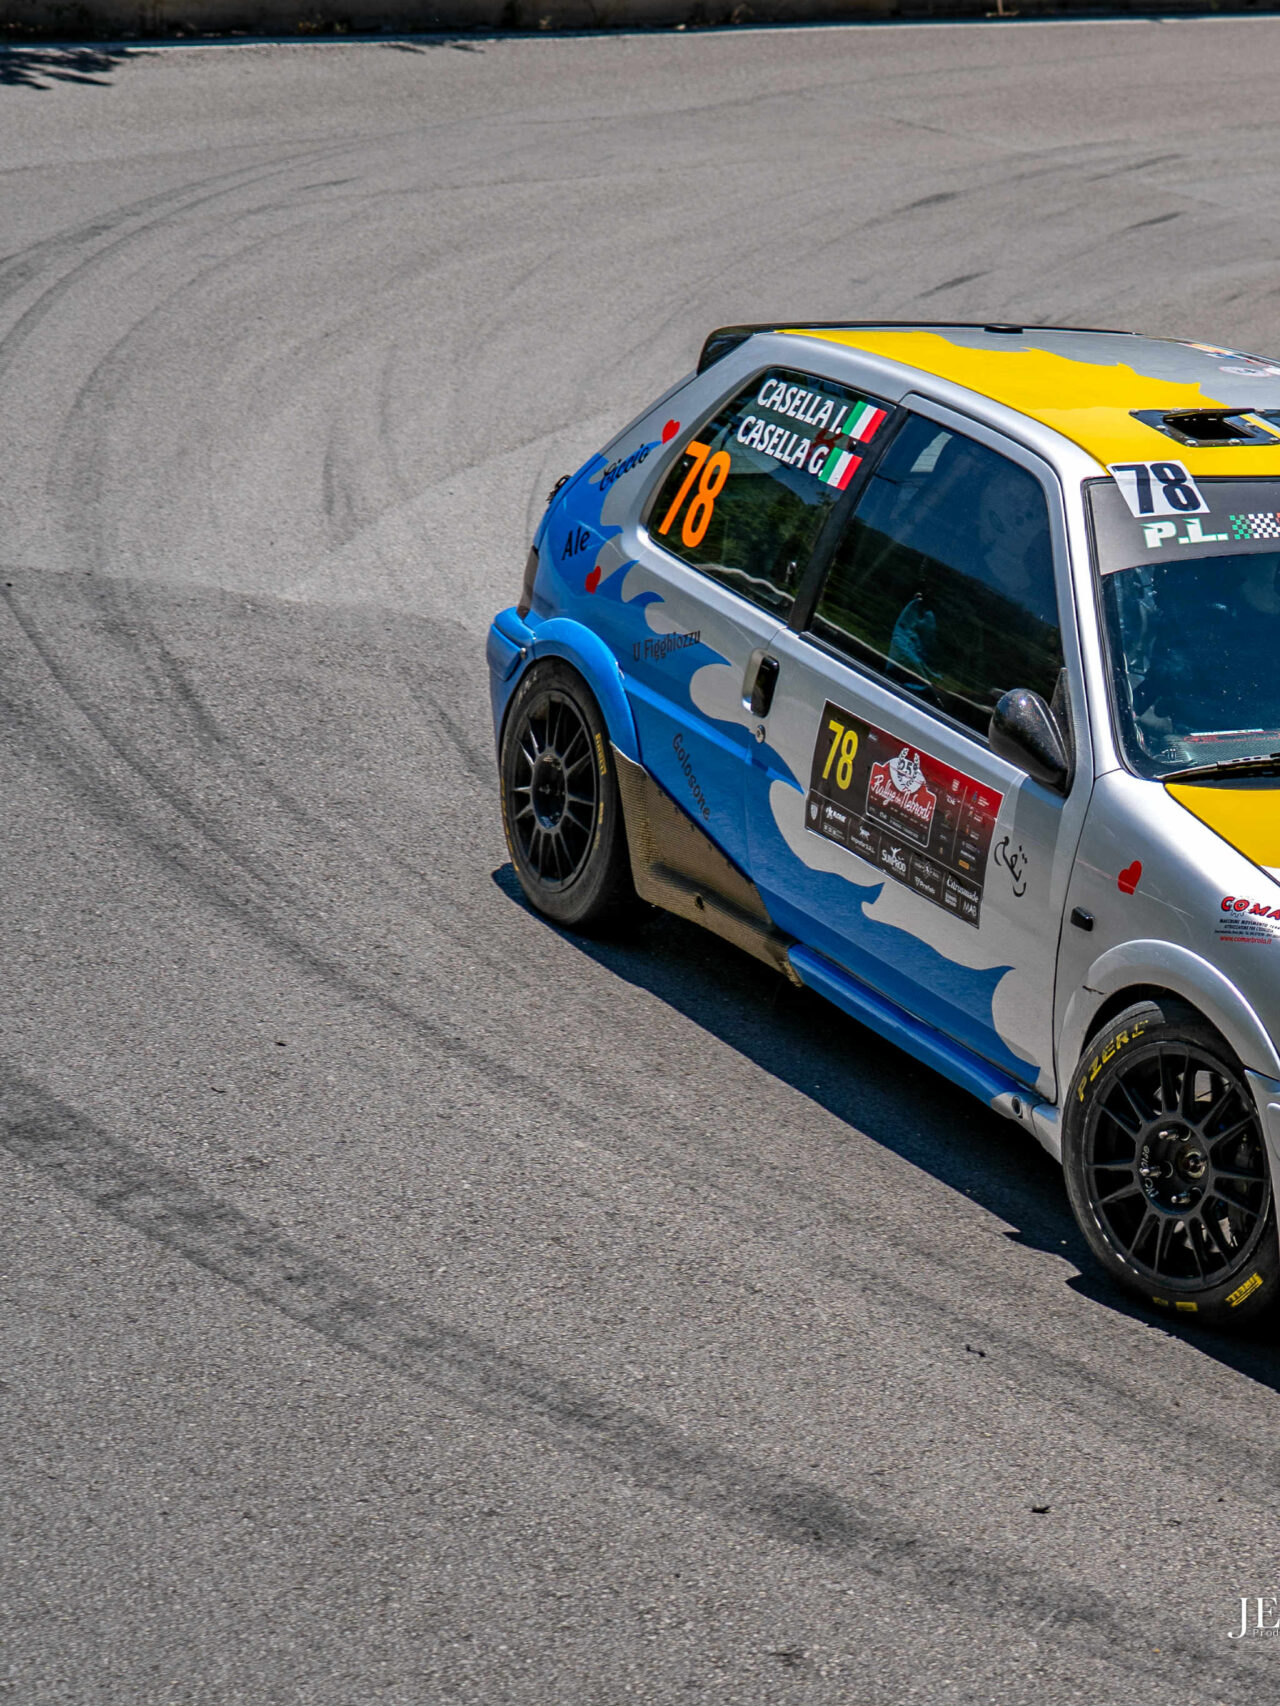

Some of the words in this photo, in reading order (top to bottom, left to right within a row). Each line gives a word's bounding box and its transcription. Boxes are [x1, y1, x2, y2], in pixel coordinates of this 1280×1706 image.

[758, 378, 834, 429] CASELLA
[829, 404, 848, 434] I.
[736, 414, 810, 464] CASELLA
[807, 444, 830, 477] G.
[658, 440, 731, 548] 78
[1112, 462, 1202, 514] 78
[562, 528, 590, 560] Ale
[1140, 517, 1230, 549] P.L.
[643, 628, 701, 661] Figghiozzu
[671, 732, 711, 821] Golosone
[822, 720, 858, 790] 78
[871, 774, 896, 806] Rallye
